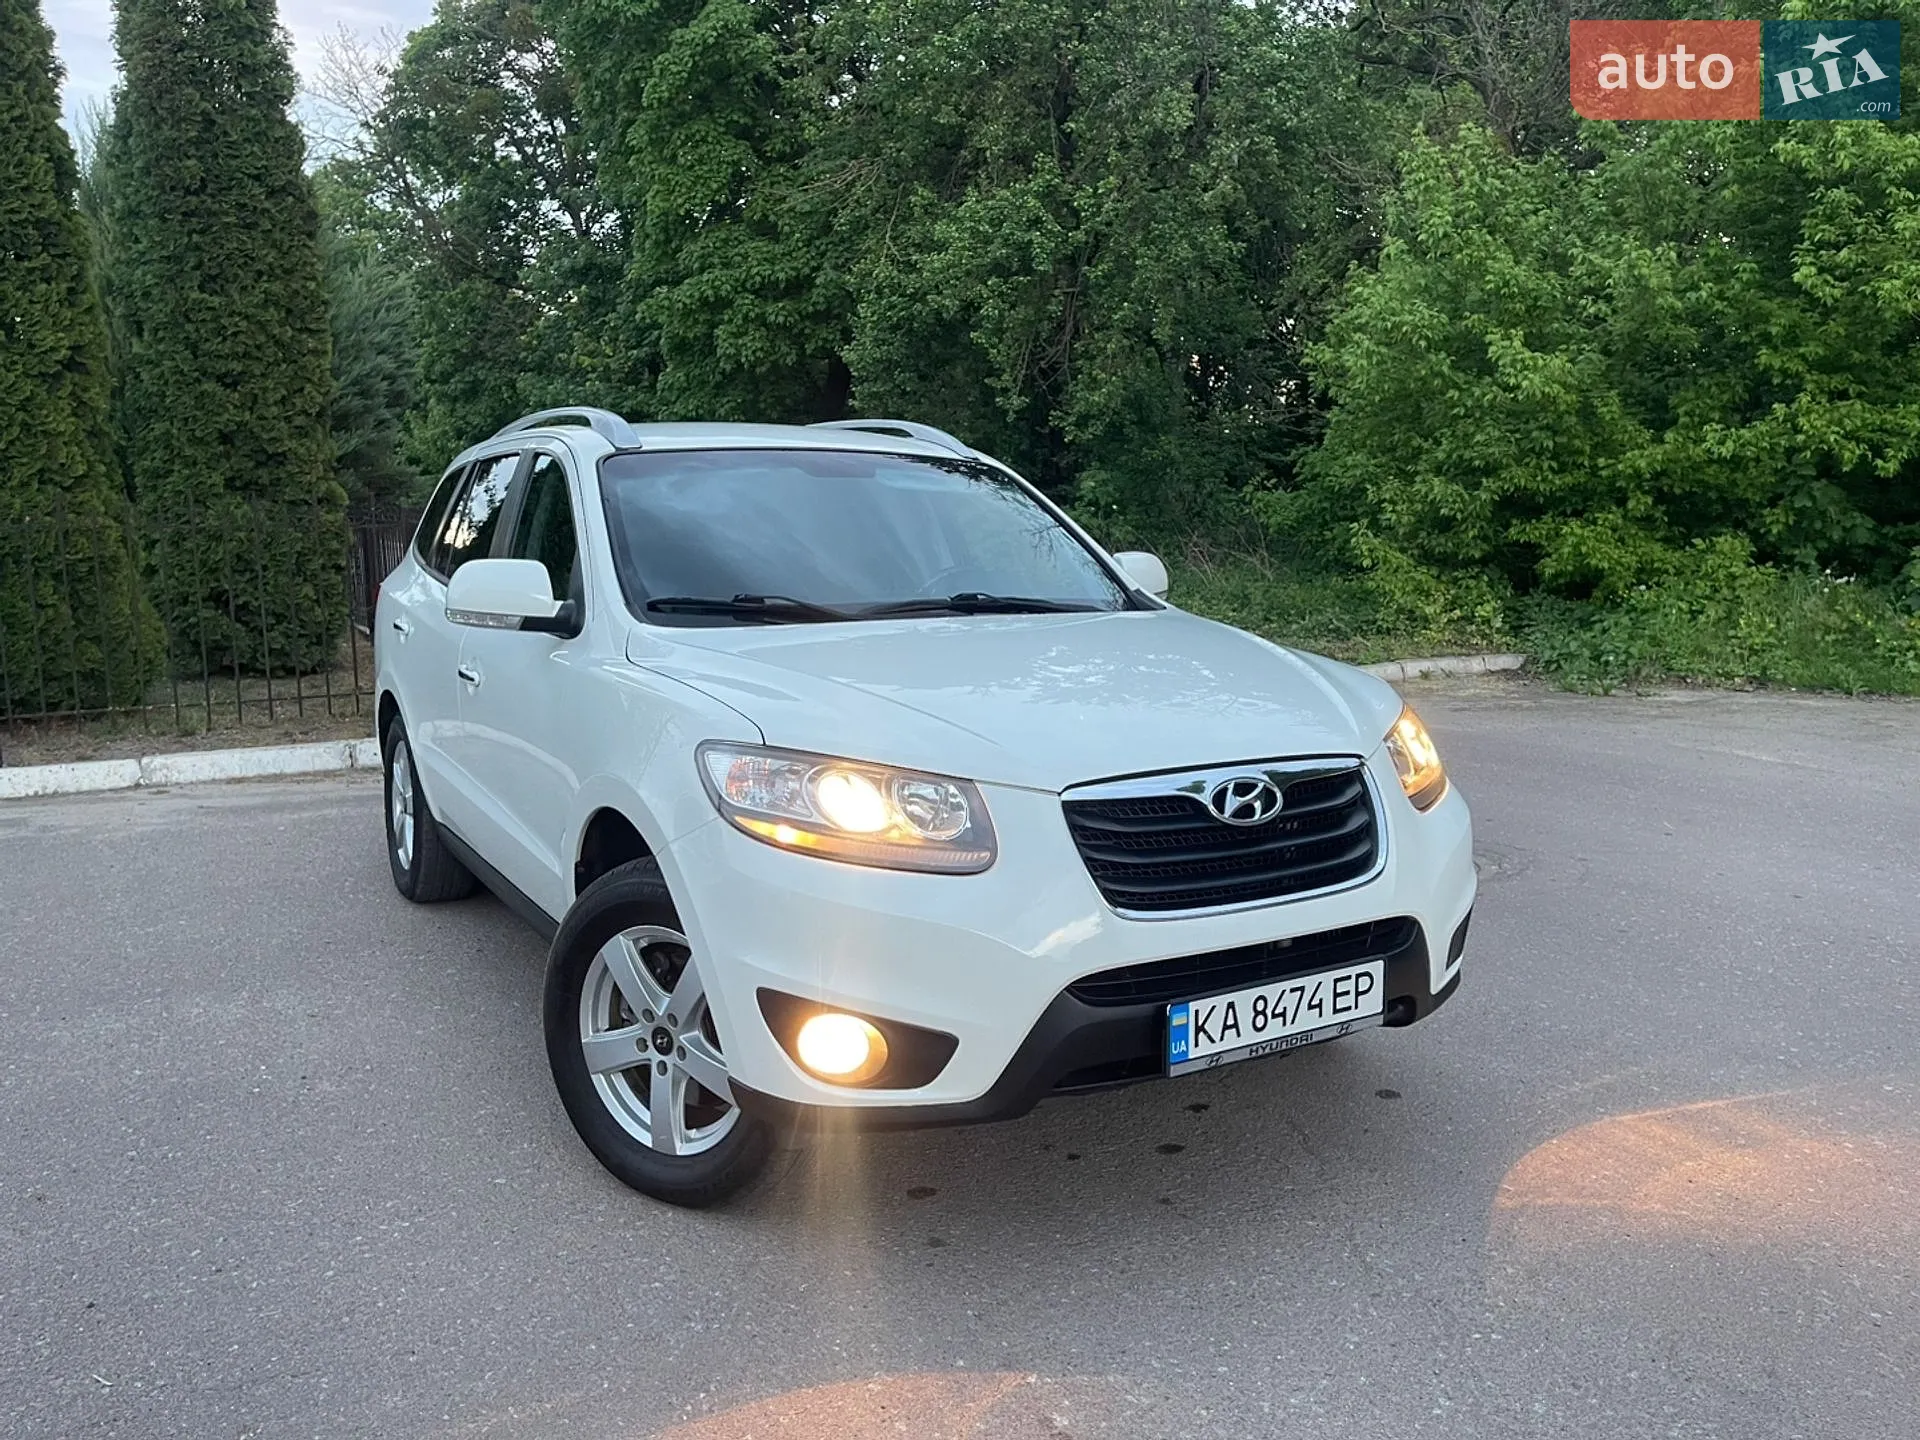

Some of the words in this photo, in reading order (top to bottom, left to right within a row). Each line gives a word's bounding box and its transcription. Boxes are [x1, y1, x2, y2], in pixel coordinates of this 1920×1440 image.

[1194, 1001, 1241, 1048] KA
[1251, 981, 1323, 1033] 8474
[1332, 970, 1375, 1015] EP
[1171, 1040, 1187, 1054] UA
[1248, 1033, 1314, 1056] HYUNDAI
